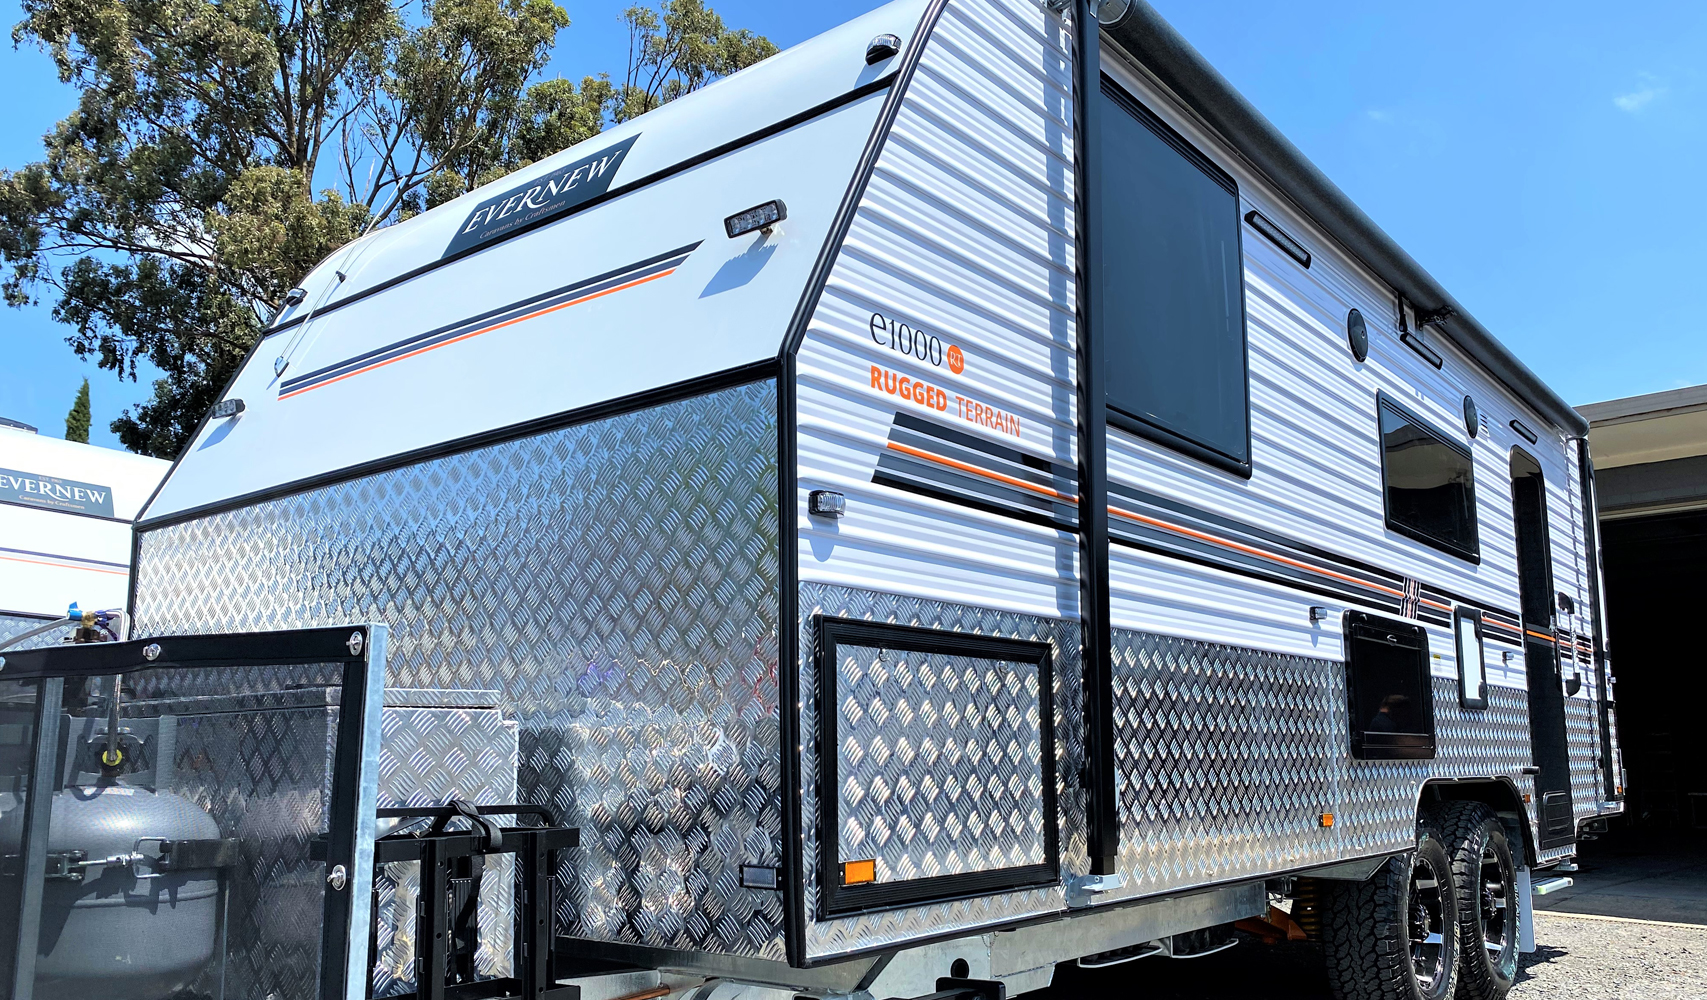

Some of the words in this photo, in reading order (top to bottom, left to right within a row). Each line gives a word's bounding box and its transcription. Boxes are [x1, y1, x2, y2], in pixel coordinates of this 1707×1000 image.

[462, 150, 622, 235] EVERNEW
[480, 221, 513, 239] Caravans
[514, 216, 525, 226] by
[525, 201, 566, 221] Craftsmen
[869, 313, 942, 366] e1000
[870, 365, 947, 412] RUGGED
[955, 395, 1021, 438] TERRAIN
[0, 474, 106, 505] EVERNEW
